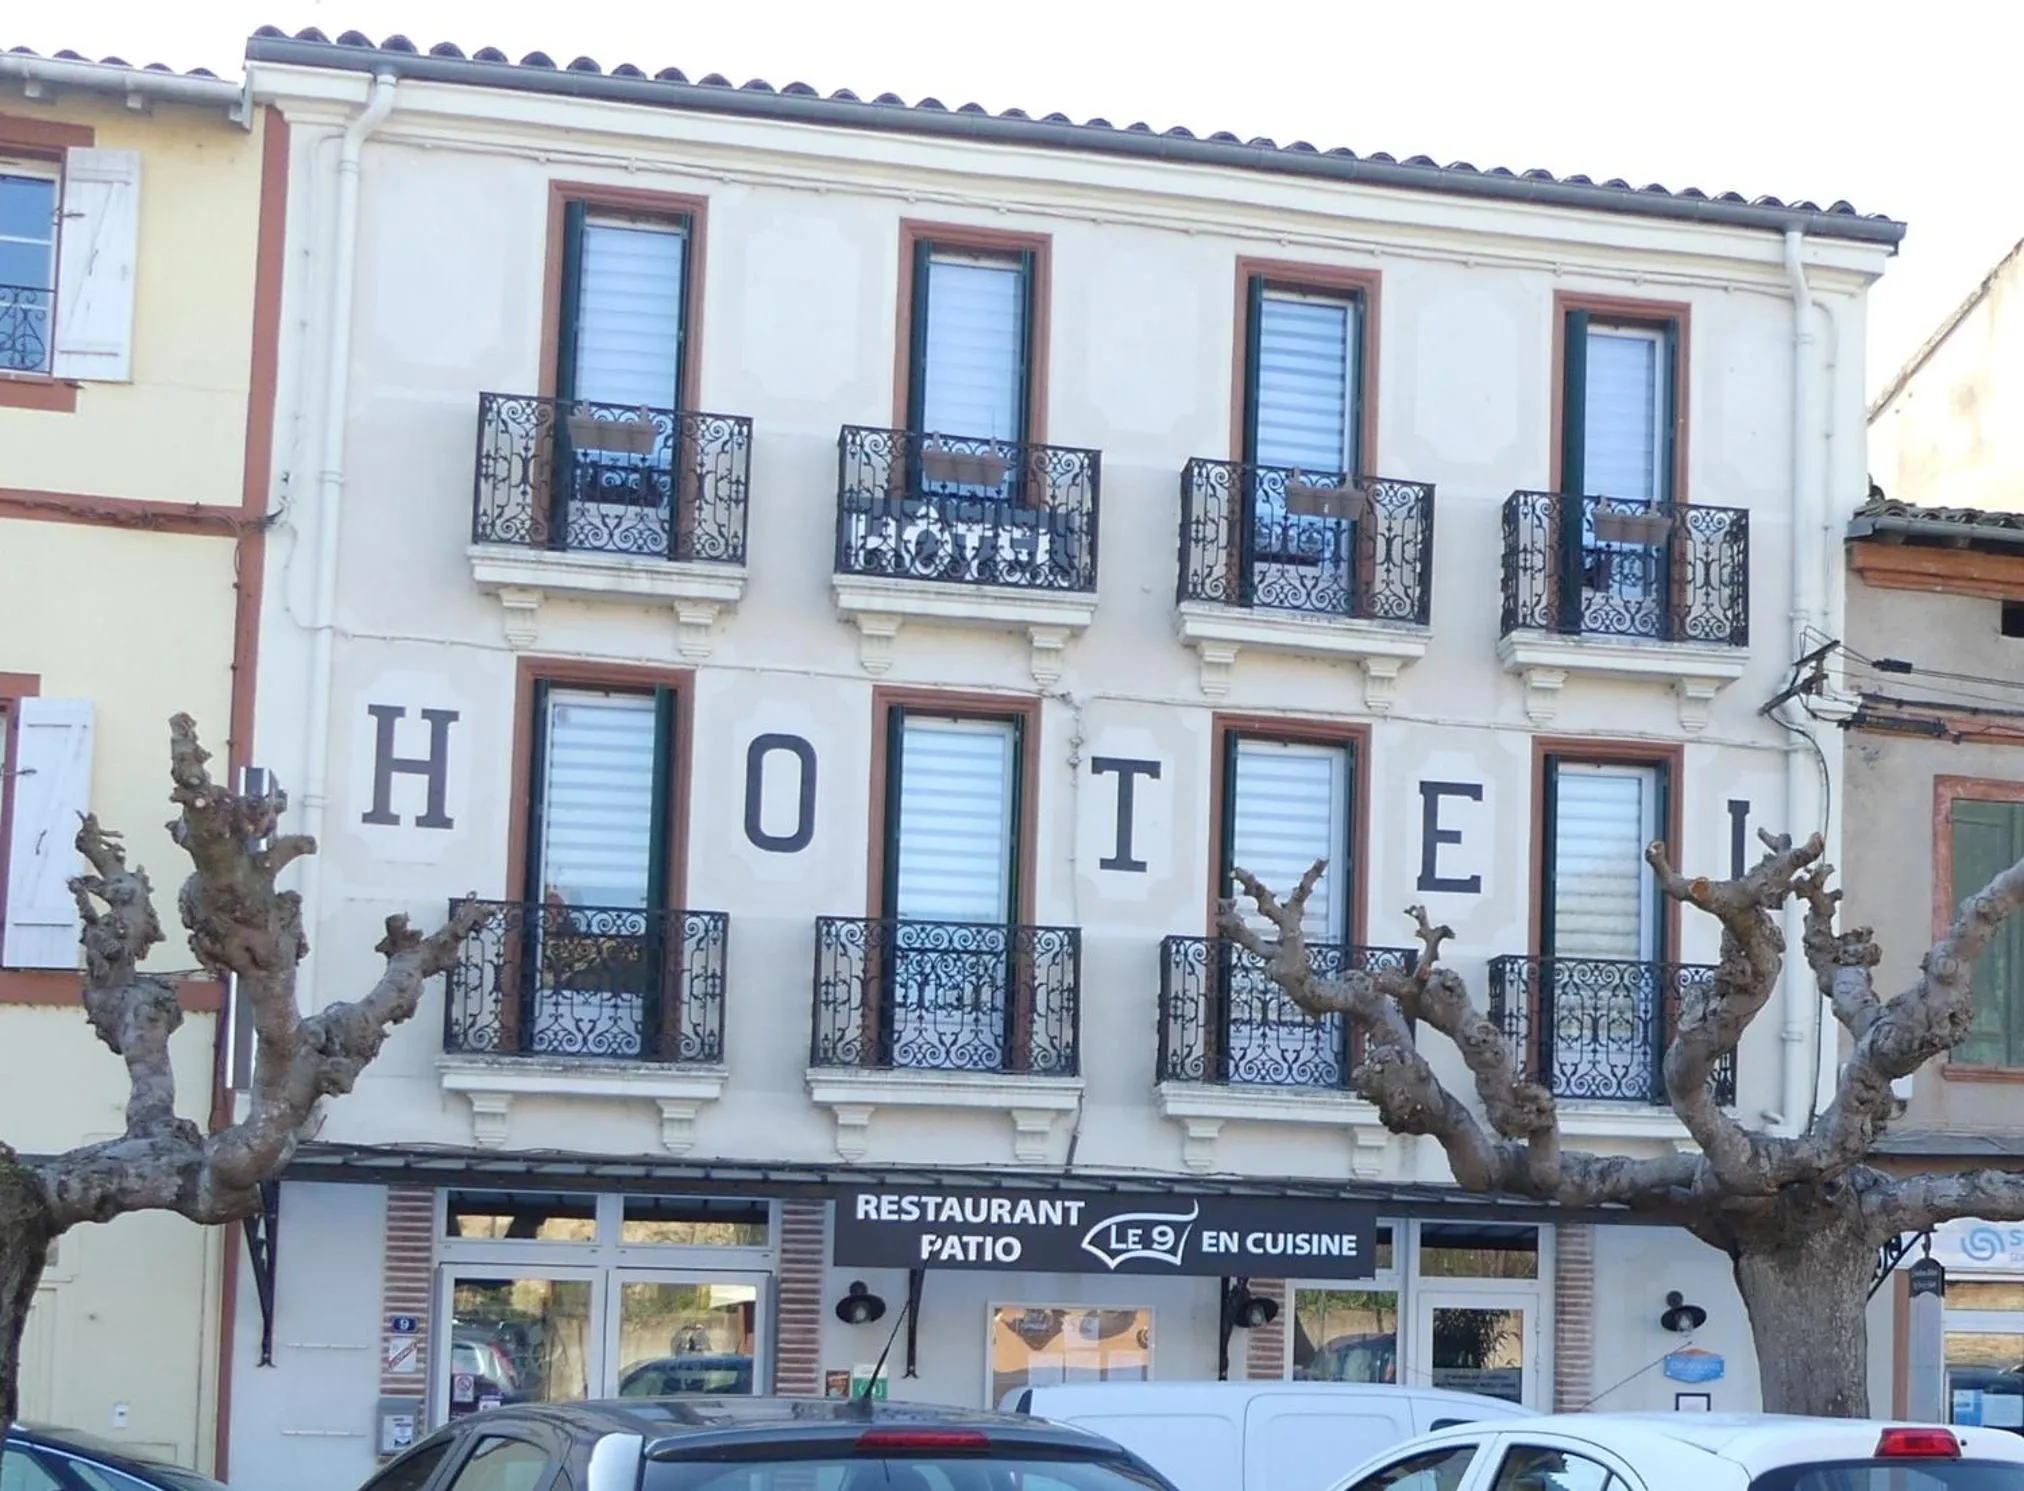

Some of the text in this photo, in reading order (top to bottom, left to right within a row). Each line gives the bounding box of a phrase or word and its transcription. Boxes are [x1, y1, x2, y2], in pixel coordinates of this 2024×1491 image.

[856, 1194, 1085, 1226] RESTAURANT
[921, 1234, 1022, 1262] PATIO
[1109, 1224, 1176, 1251] LE 9
[1201, 1231, 1357, 1256] EN CUISINE
[400, 1319, 410, 1330] 9
